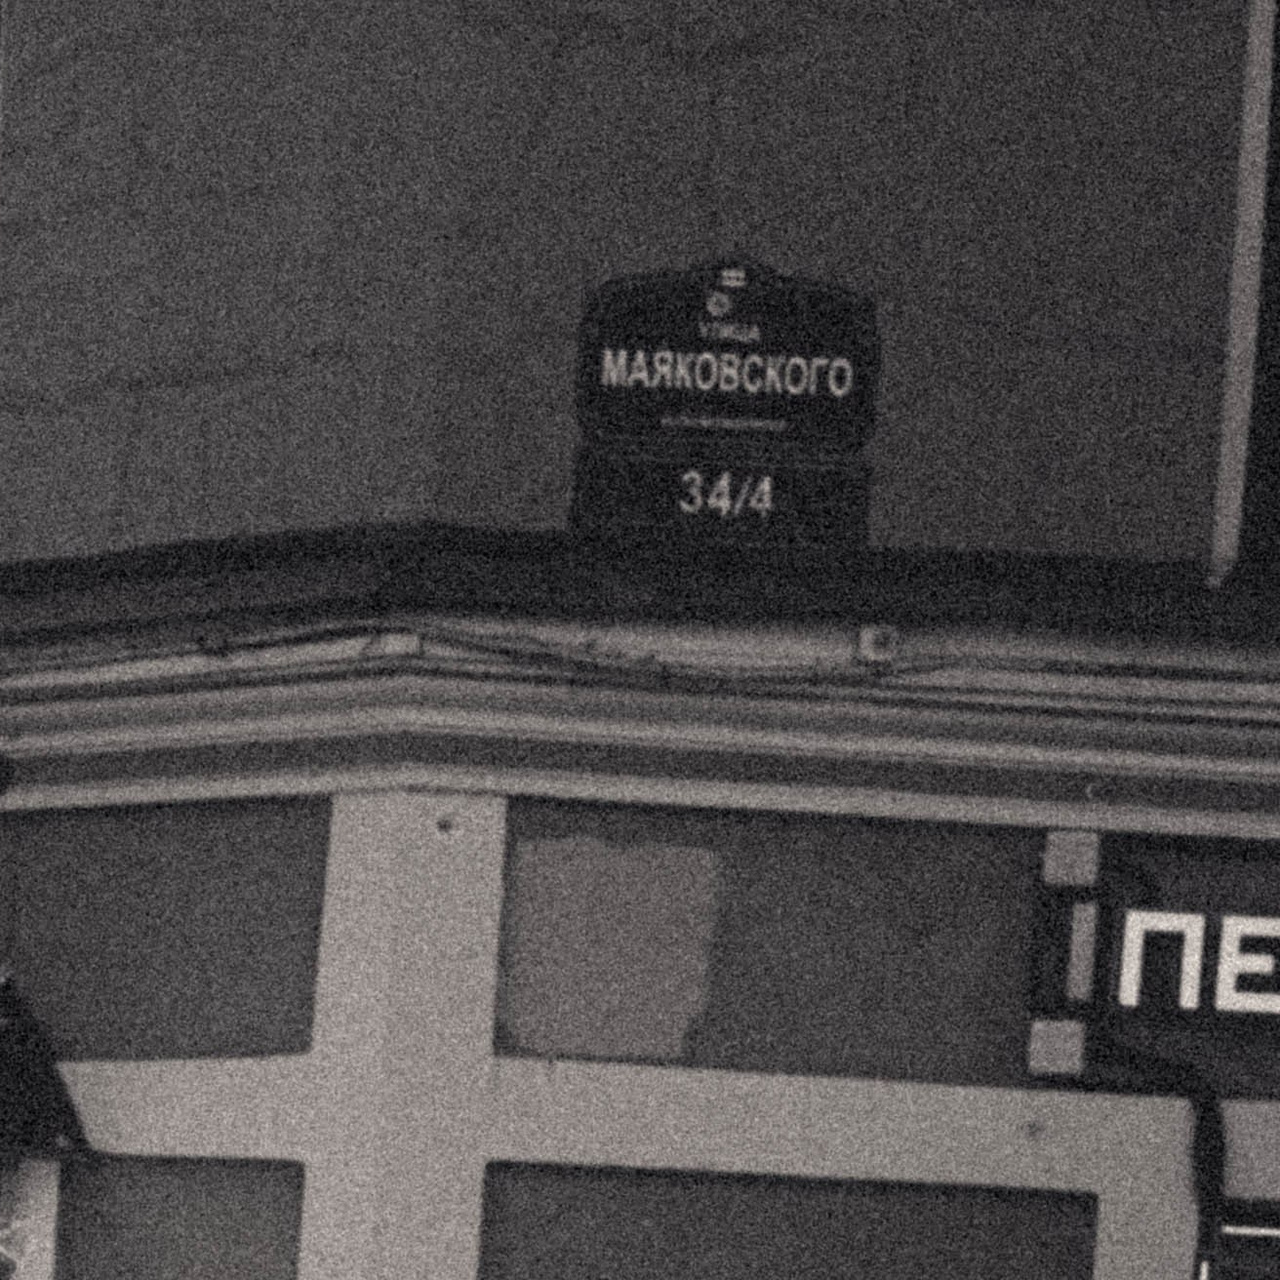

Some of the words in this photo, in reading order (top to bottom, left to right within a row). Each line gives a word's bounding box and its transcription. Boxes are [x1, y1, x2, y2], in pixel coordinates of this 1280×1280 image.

[601, 350, 853, 396] МАЯКОВСКОГО
[680, 472, 771, 515] 34/4
[1120, 911, 1280, 1012] ПЕ
